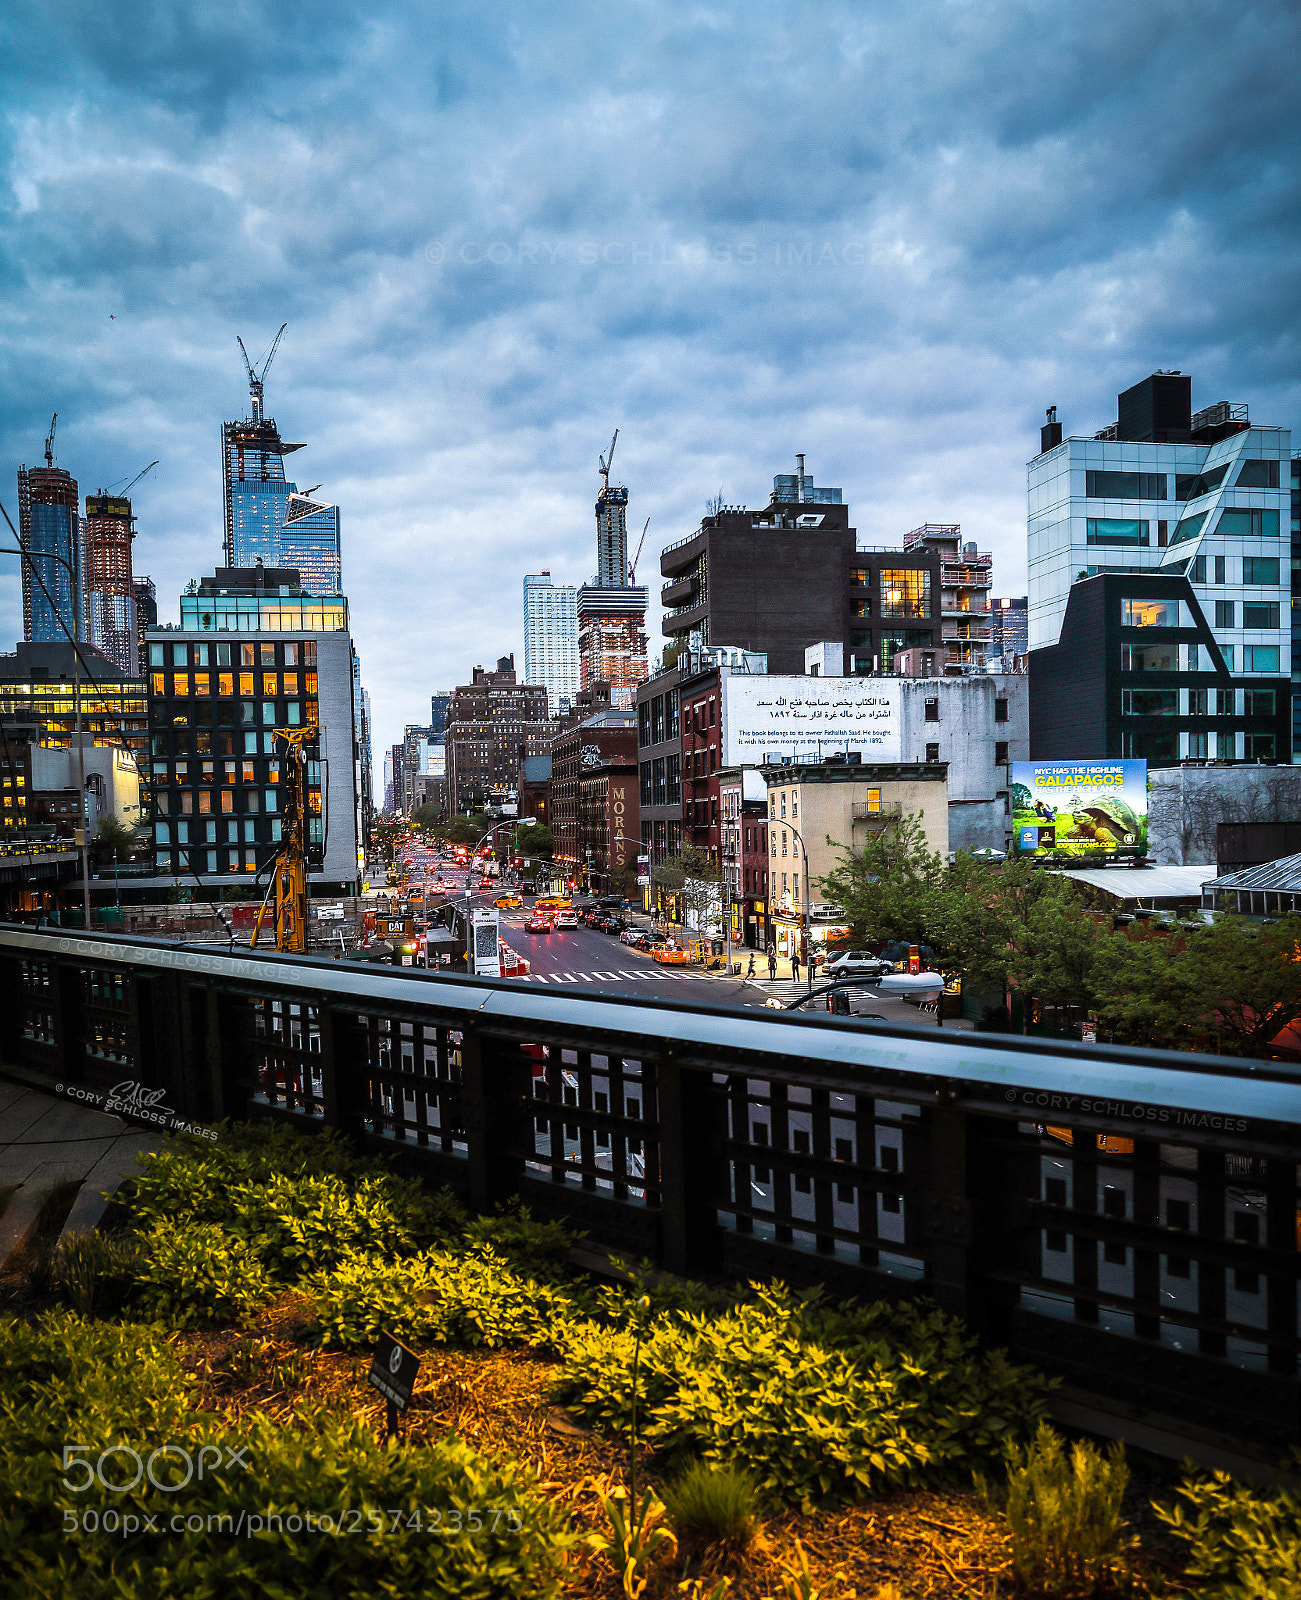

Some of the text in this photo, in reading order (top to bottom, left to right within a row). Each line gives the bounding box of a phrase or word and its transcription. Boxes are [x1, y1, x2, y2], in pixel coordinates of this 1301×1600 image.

[775, 696, 786, 706] الله
[790, 698, 802, 709] فتح
[805, 698, 829, 708] صاحبه
[832, 698, 852, 708] يخص
[856, 698, 876, 708] الكتاب
[879, 698, 890, 706] هذا
[869, 710, 890, 719] اشتراه
[388, 921, 404, 932] CAT
